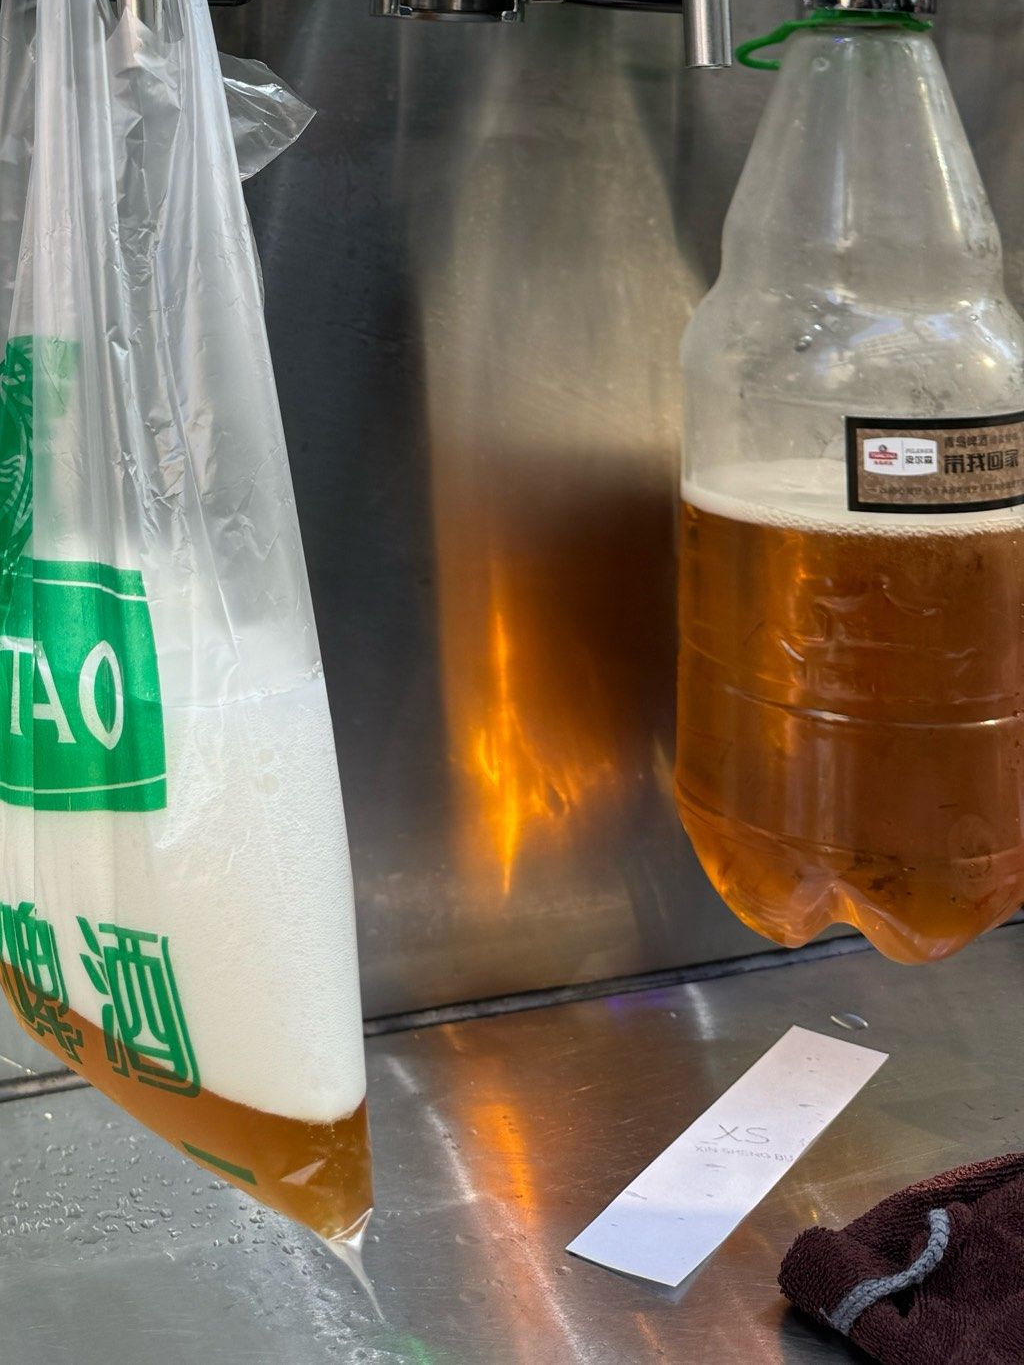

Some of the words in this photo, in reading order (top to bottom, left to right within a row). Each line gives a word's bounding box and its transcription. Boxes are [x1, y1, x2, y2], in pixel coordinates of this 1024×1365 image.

[943, 448, 1020, 475] 带我回家
[713, 1124, 770, 1144] XS
